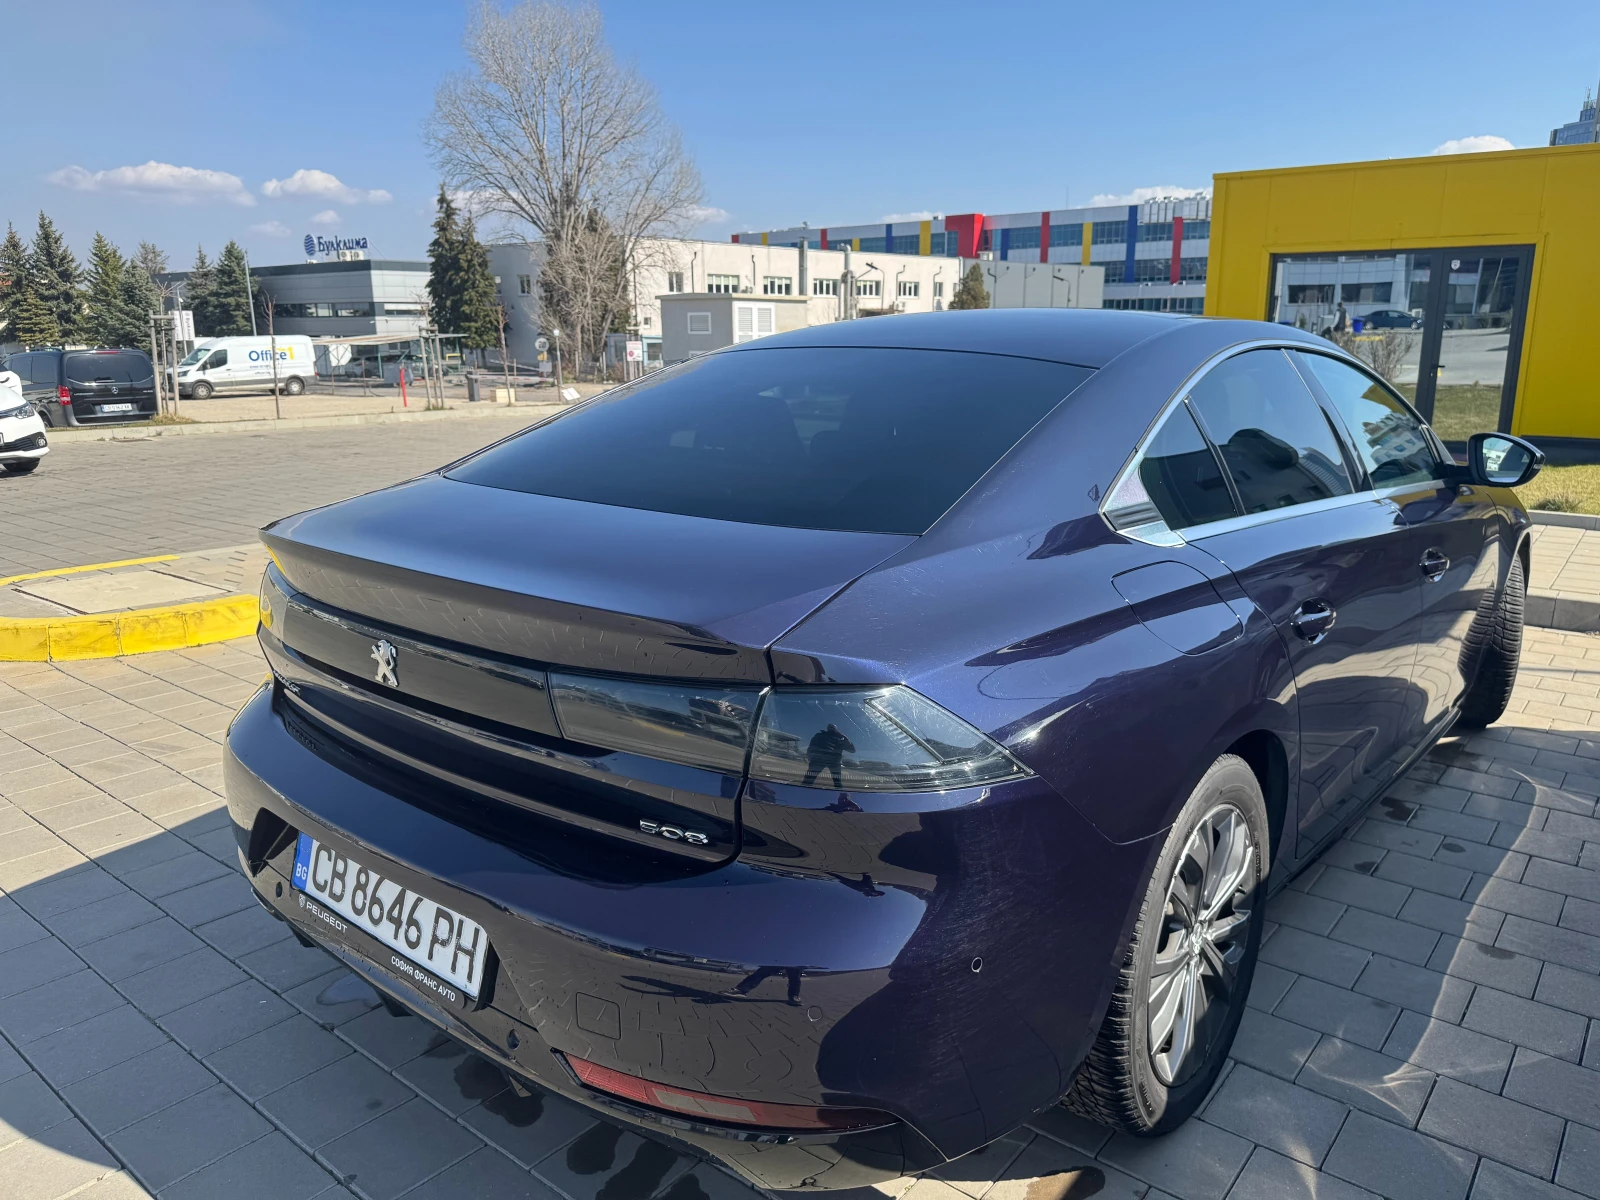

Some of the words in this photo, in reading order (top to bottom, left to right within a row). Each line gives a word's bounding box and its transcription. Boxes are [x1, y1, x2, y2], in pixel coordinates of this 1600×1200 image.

[639, 819, 709, 845] 508
[295, 862, 308, 881] BG
[306, 901, 348, 934] PEUGEOT
[312, 842, 348, 903] CB
[350, 865, 424, 950] 8646
[427, 906, 480, 984] PH
[391, 955, 414, 976] СОФИЯ
[414, 970, 438, 990] ФРАНС
[437, 986, 456, 1002] АУТО
